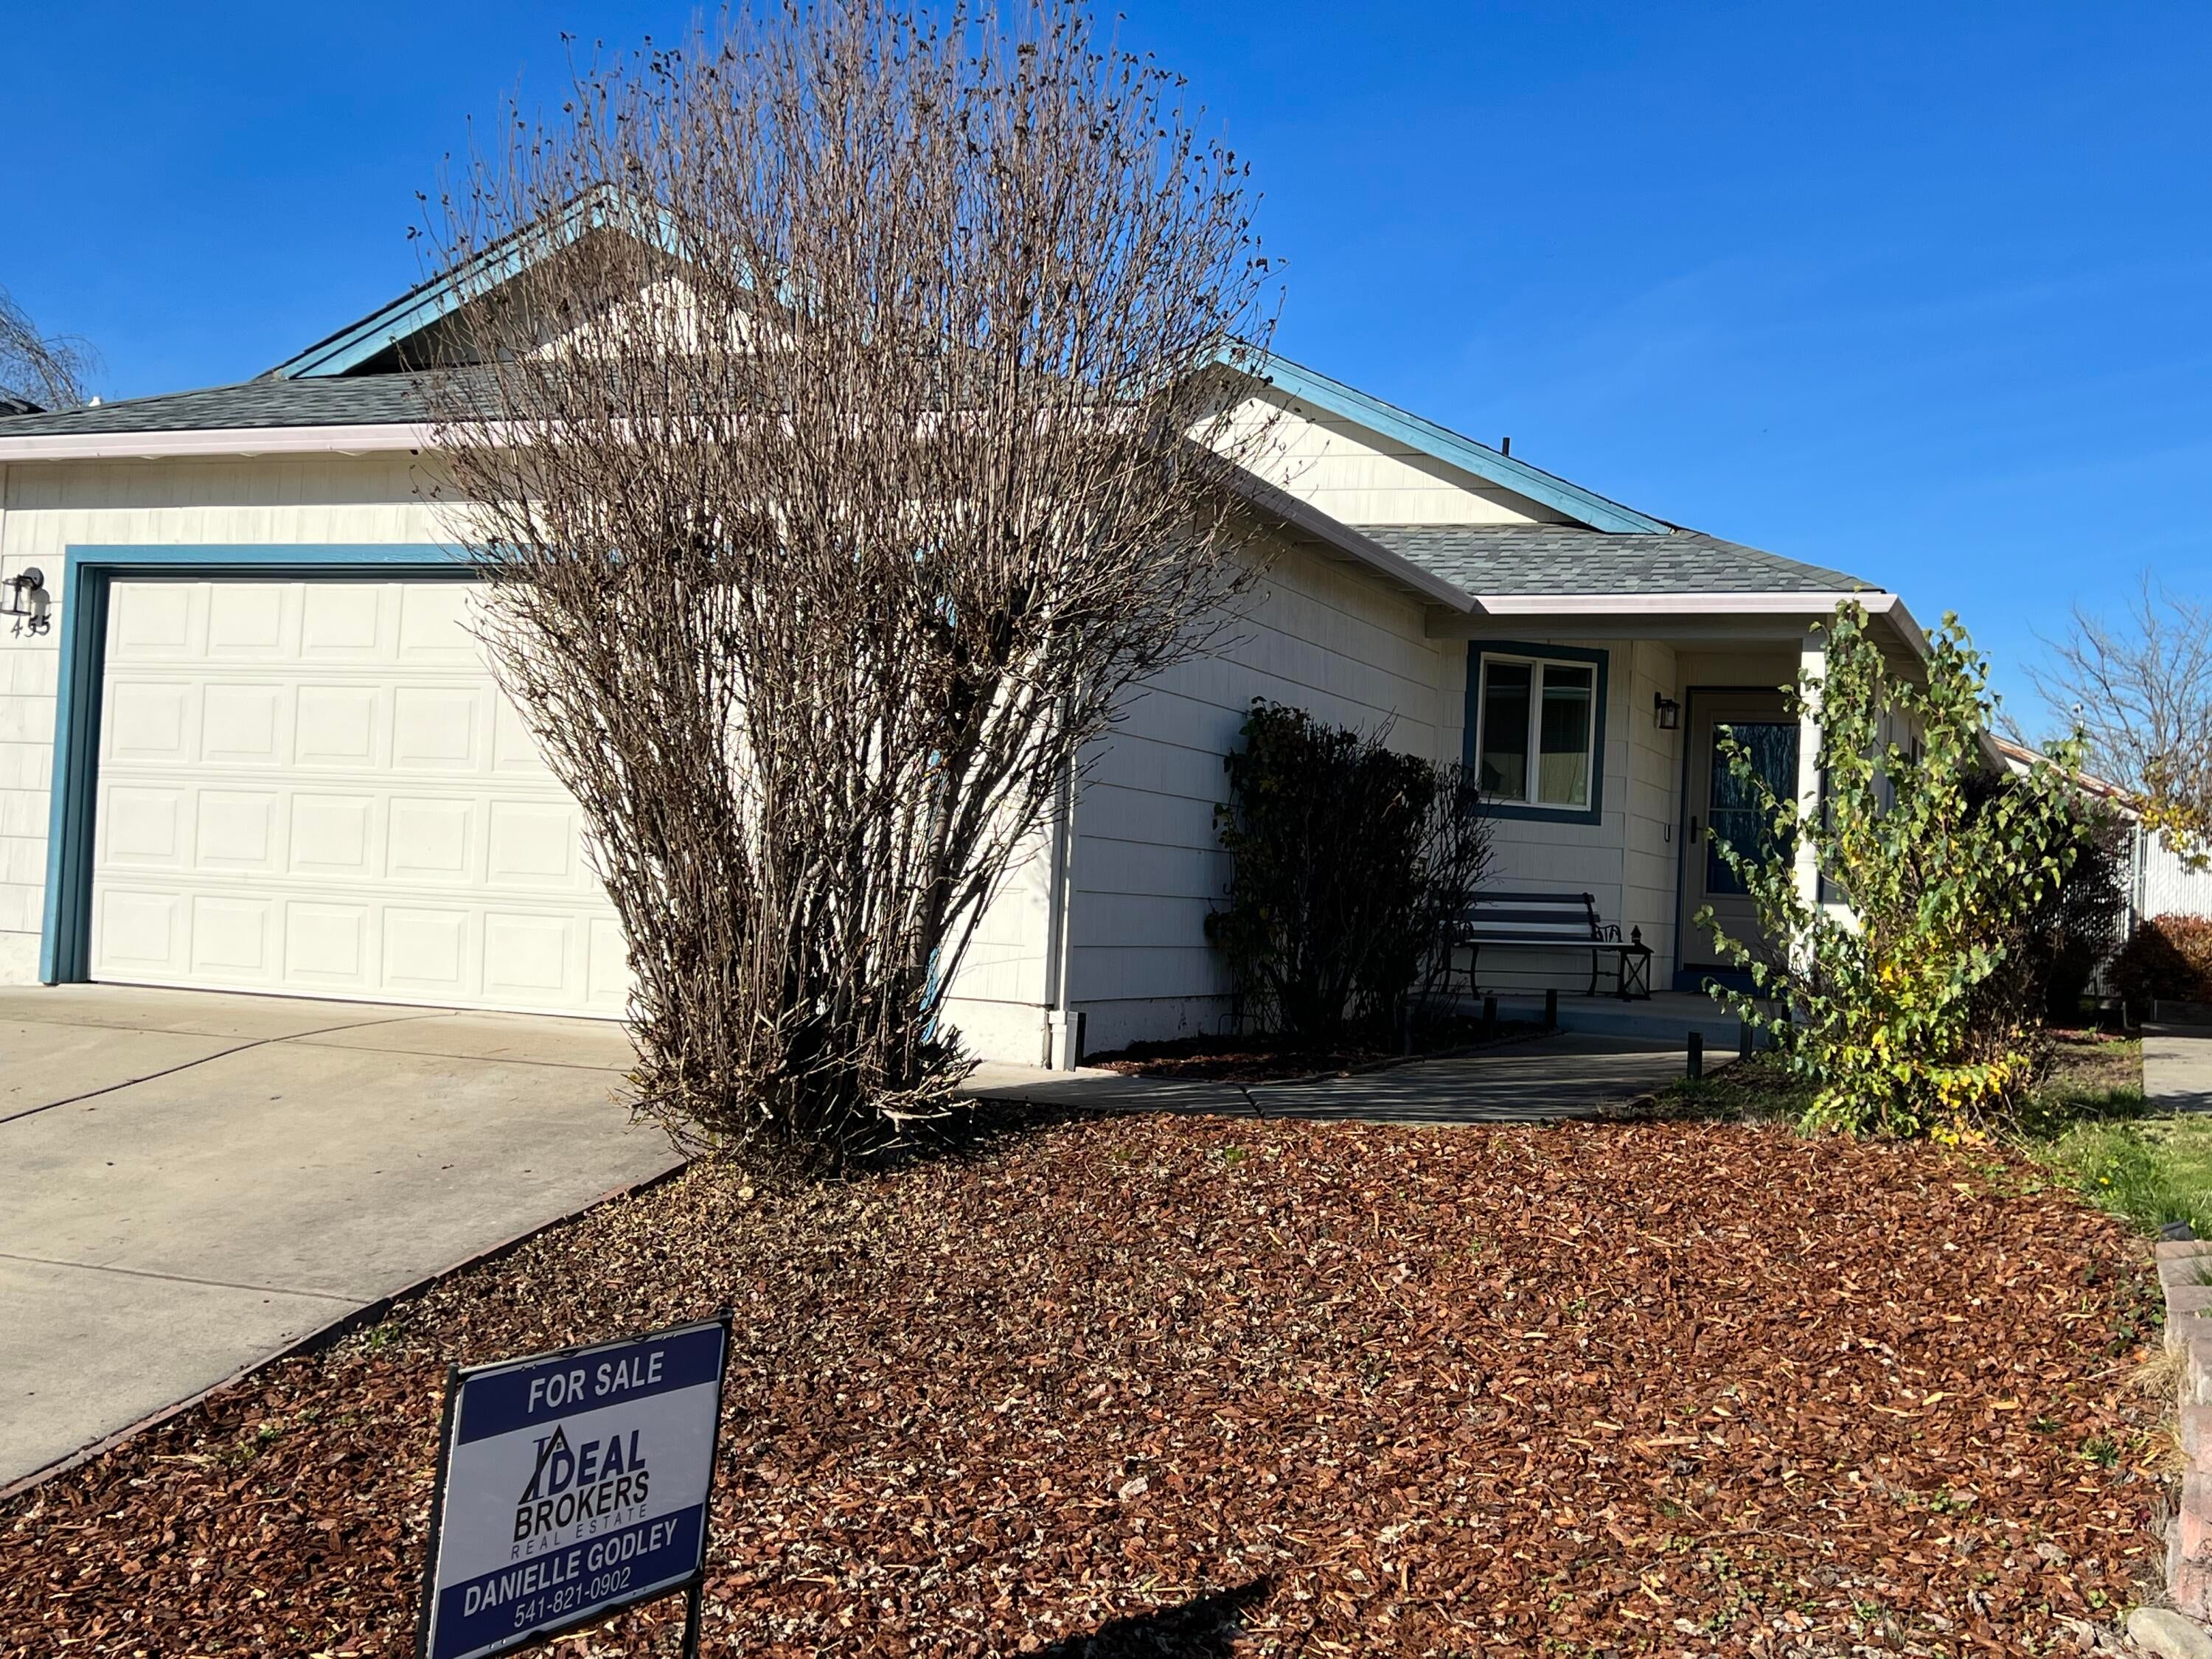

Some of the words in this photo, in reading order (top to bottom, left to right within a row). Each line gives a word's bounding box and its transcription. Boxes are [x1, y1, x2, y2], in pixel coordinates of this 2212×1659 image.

[528, 1369, 586, 1413] FOR
[595, 1351, 664, 1397] SALE
[510, 1535, 562, 1560] REAL
[576, 1503, 647, 1539] ESTATE
[513, 1471, 650, 1543] BROKERS
[463, 1549, 581, 1618] DANIELLE
[587, 1519, 678, 1573] GODLEY
[514, 1567, 631, 1628] 541-821-0902
